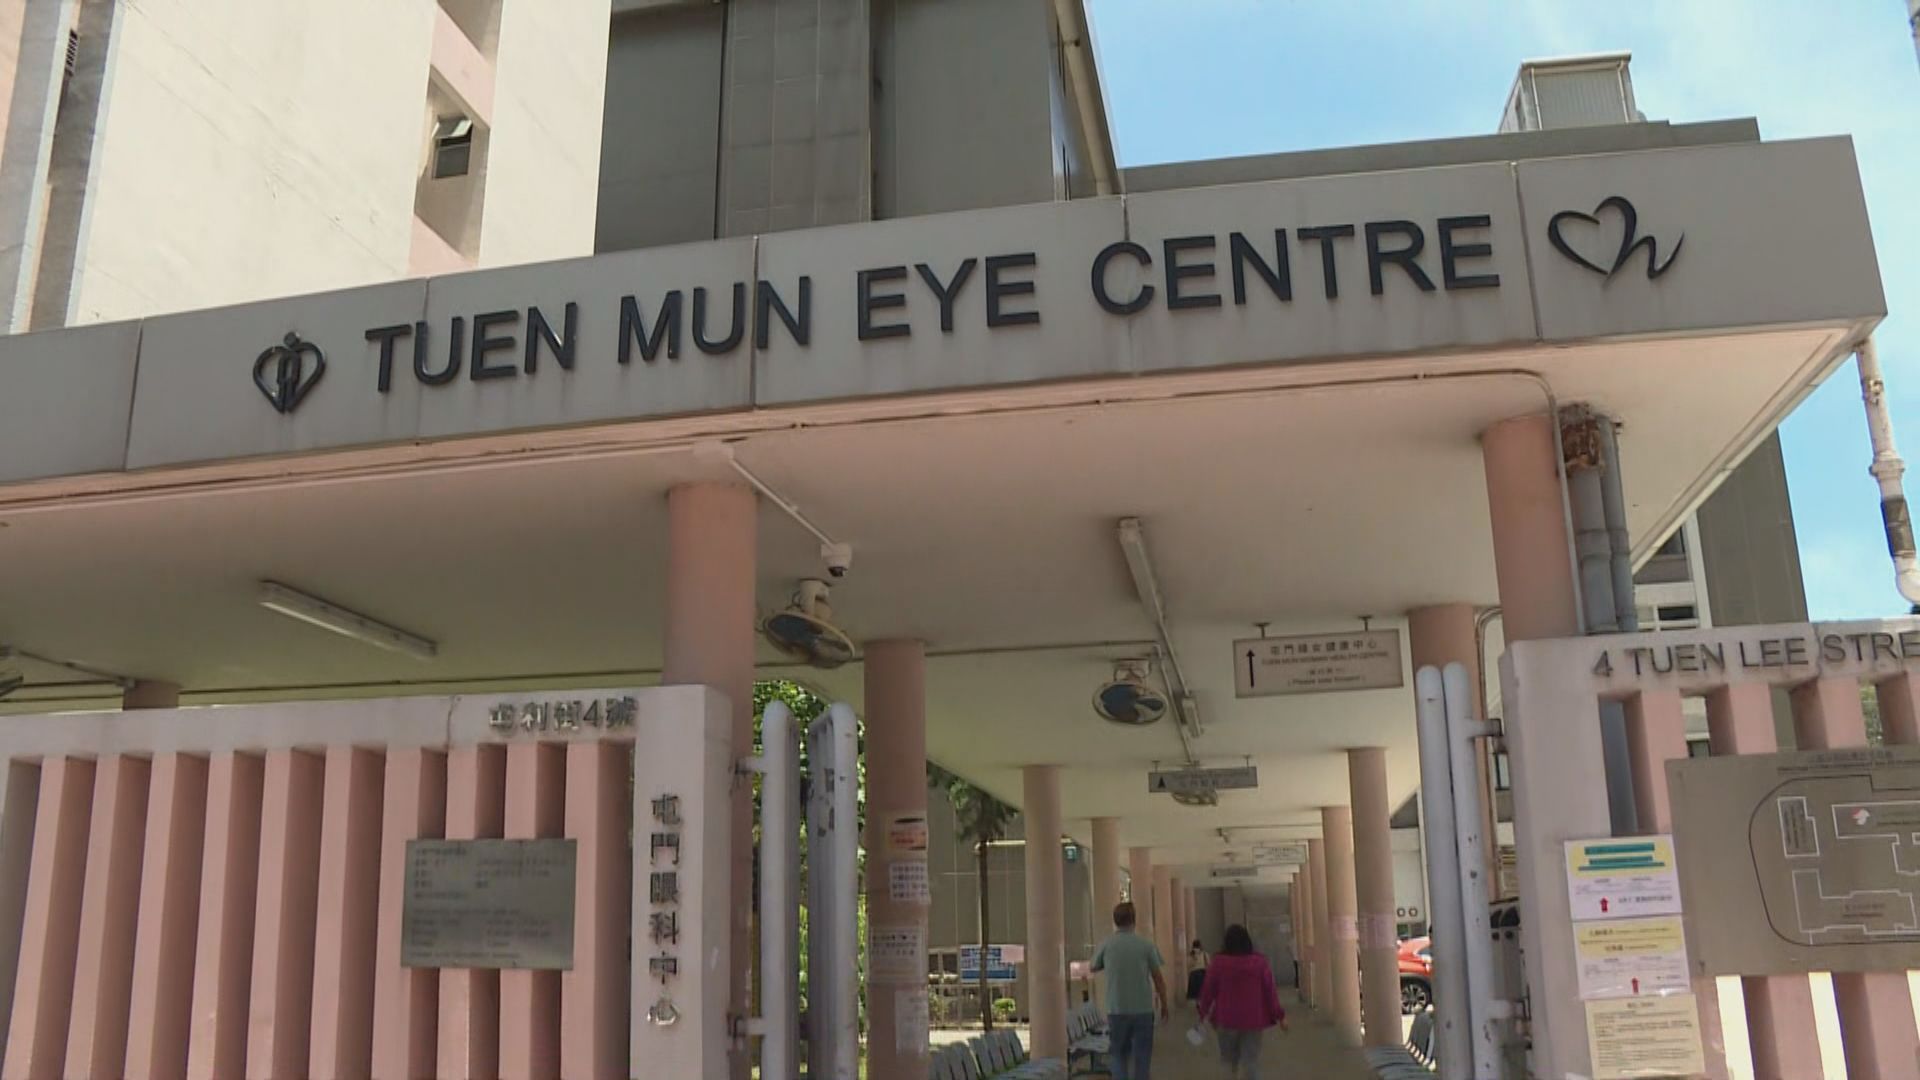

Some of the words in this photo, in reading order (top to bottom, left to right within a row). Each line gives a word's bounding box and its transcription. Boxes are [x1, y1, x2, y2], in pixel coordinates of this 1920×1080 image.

[365, 302, 577, 393] TUEN
[618, 276, 810, 364] MUN
[857, 252, 1040, 341] EYE
[1091, 214, 1500, 316] CENTRE
[1593, 651, 1613, 677] 4
[1624, 642, 1726, 676] TUEN
[1739, 637, 1809, 668] LEE
[648, 793, 682, 1025] 屯門眼科中心
